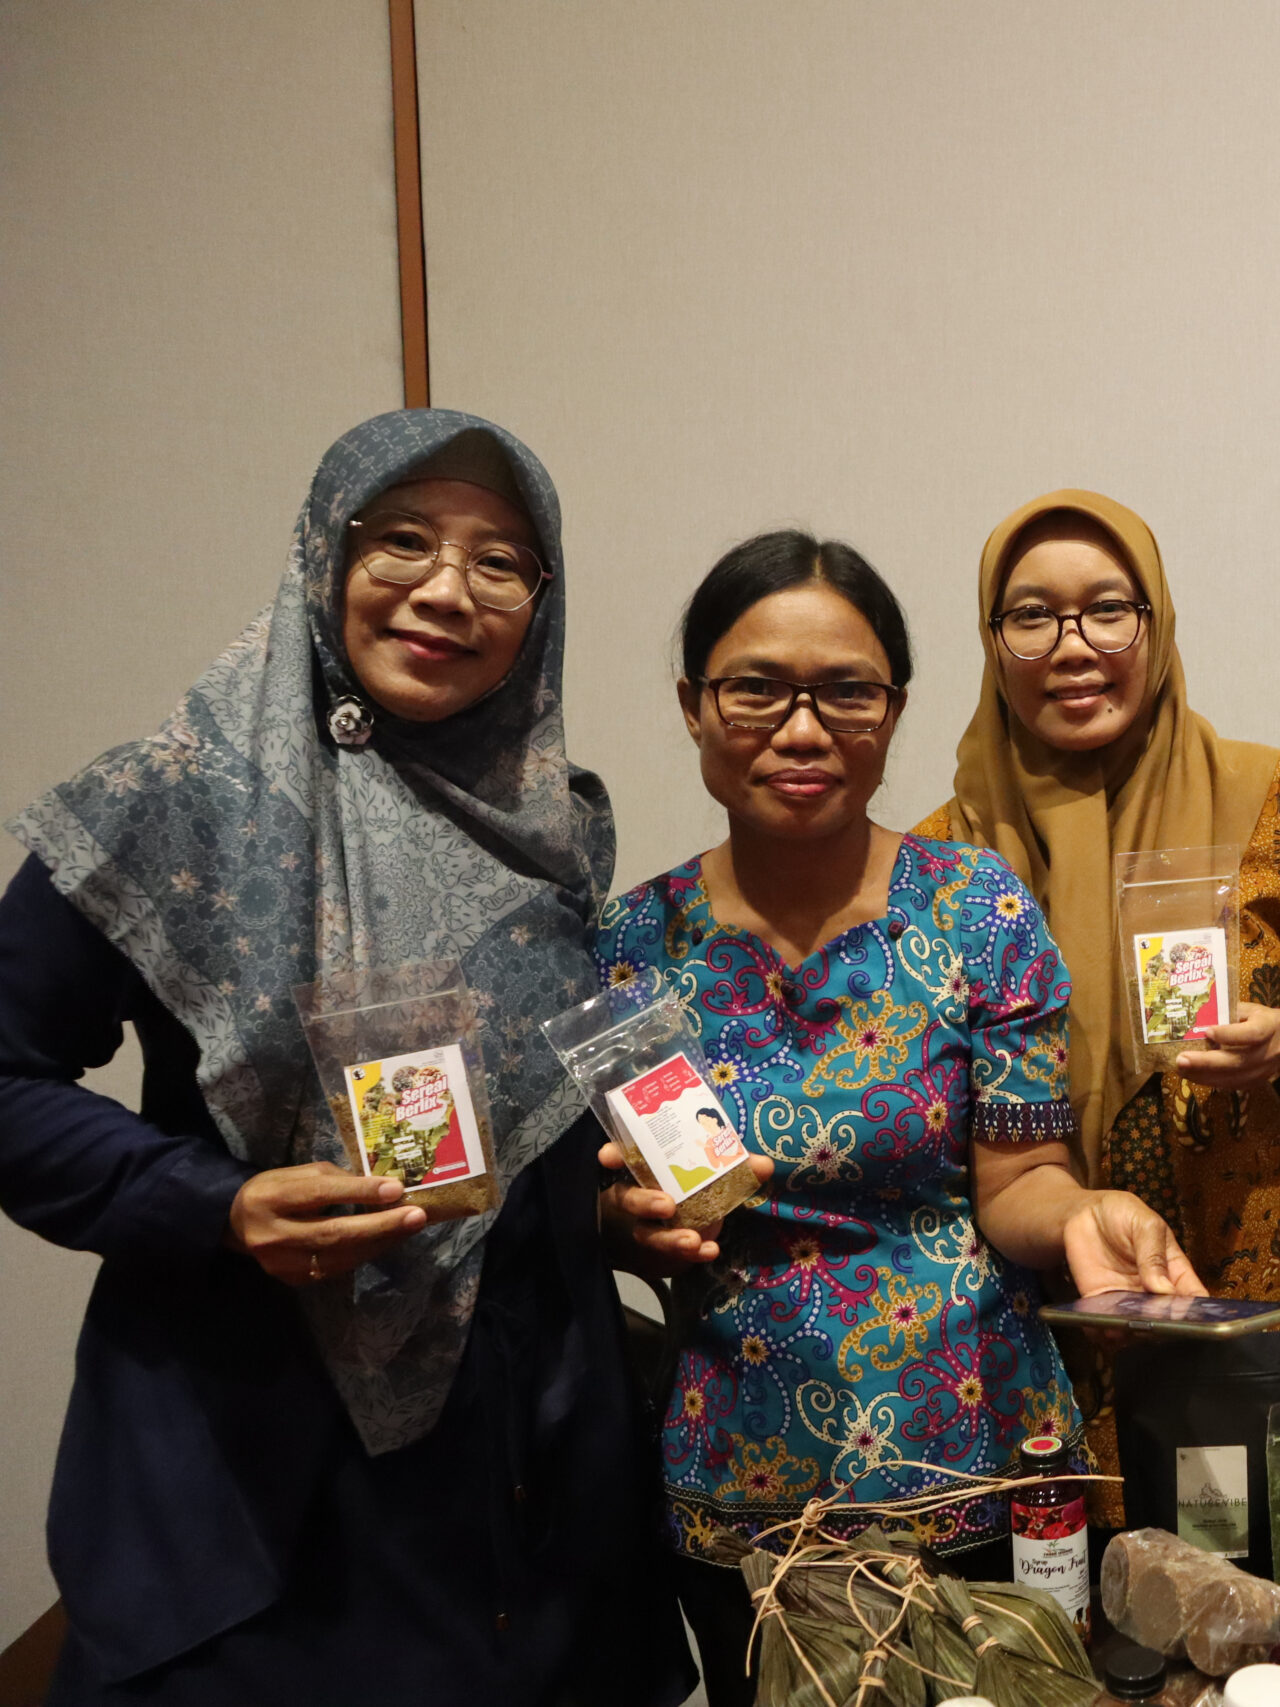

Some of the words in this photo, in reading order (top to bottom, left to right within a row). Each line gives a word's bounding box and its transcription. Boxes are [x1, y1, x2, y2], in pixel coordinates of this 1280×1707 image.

[1175, 954, 1213, 974] Sereal
[400, 1075, 448, 1105] Sereal
[395, 1096, 438, 1122] Berlix
[1019, 1558, 1066, 1579] Dragon
